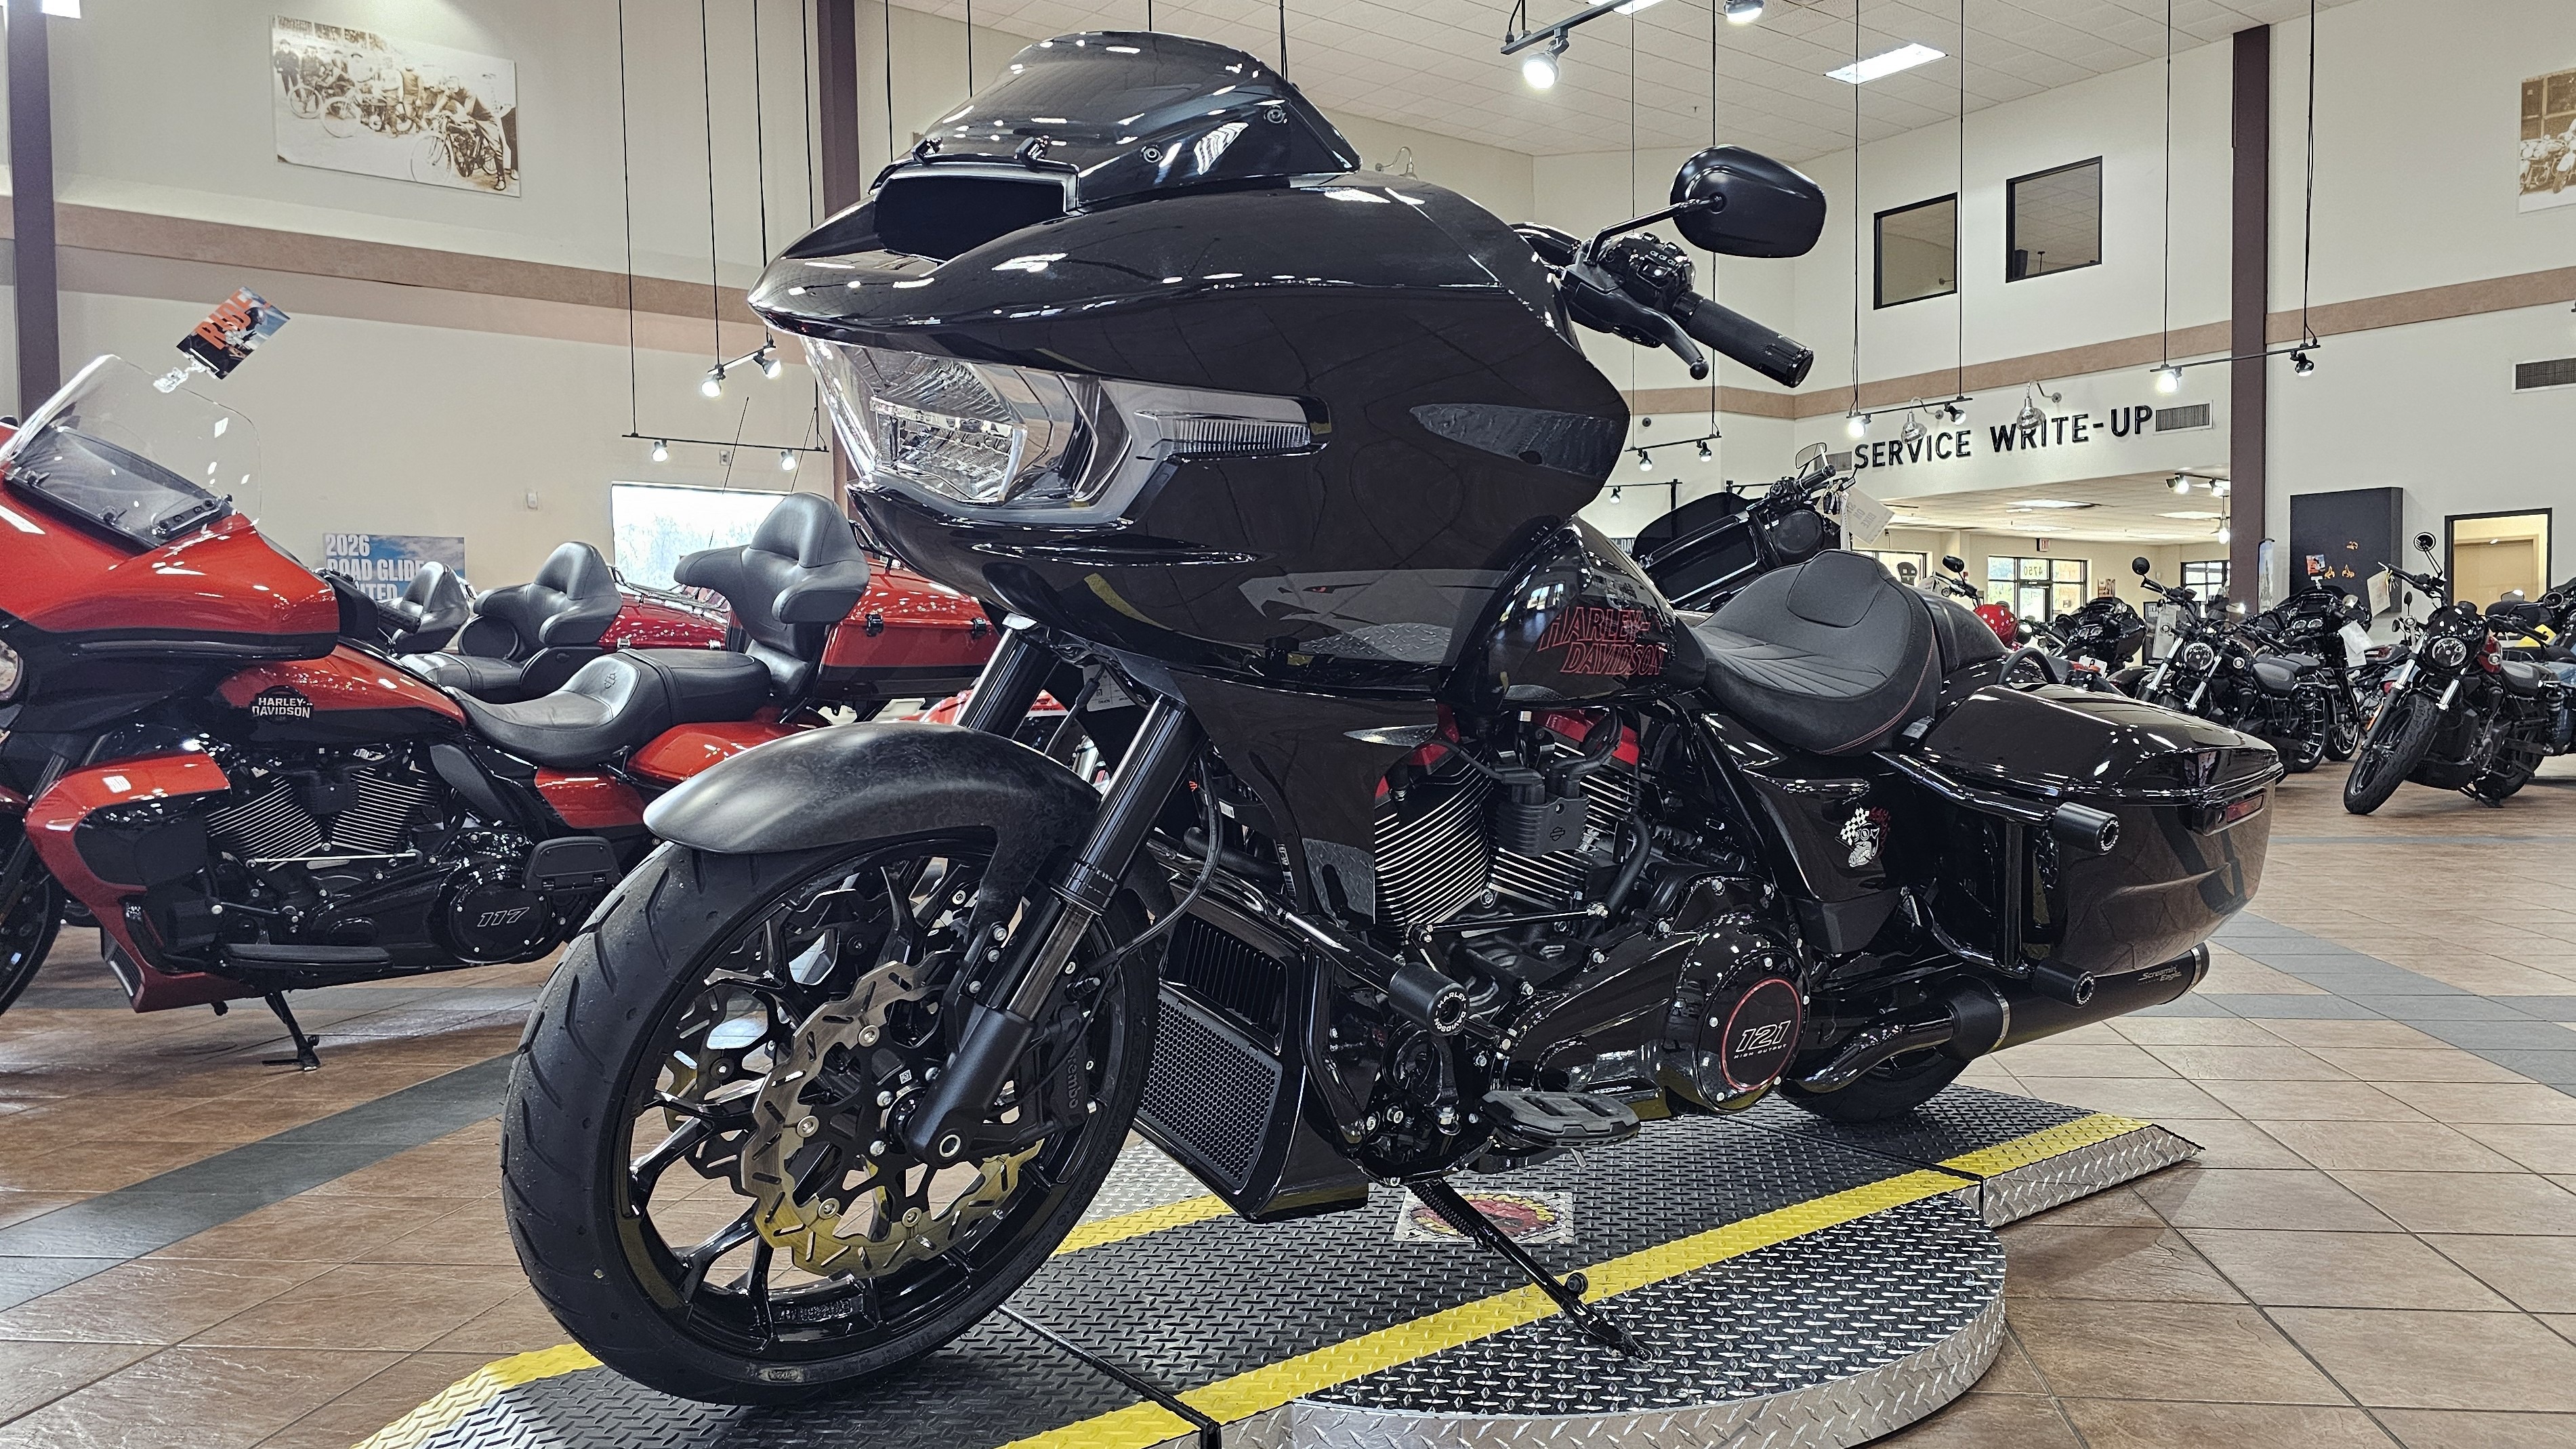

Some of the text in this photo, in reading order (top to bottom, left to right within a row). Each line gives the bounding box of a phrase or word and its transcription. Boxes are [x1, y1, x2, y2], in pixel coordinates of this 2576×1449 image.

[194, 289, 253, 350] RIDE
[1854, 405, 2153, 469] SERVICE WRITE-UP
[325, 534, 370, 556] 2026
[327, 559, 372, 581] ROAD
[1560, 642, 1665, 675] DAVIDSON
[252, 706, 310, 718] DAVIDSON
[477, 907, 530, 927] 117
[2159, 970, 2182, 982] Eagle
[1735, 1020, 1791, 1053] 121
[1734, 1043, 1787, 1059] HIGH OUTPUT
